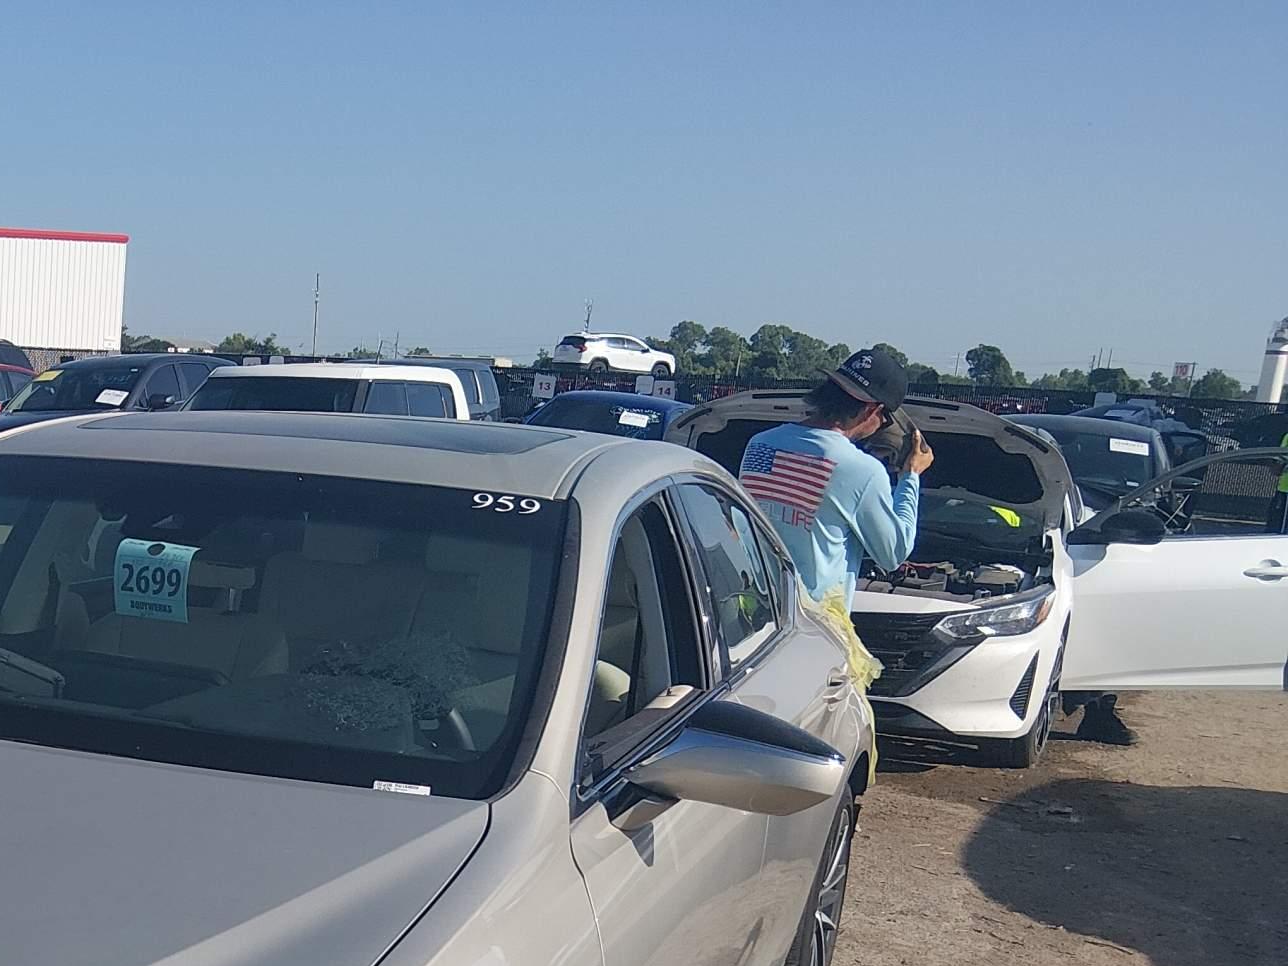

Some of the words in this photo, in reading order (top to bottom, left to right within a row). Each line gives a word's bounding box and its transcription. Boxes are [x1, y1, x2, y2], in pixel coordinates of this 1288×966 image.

[537, 381, 552, 391] 13
[657, 386, 672, 396] 14
[471, 492, 541, 514] 959
[120, 563, 182, 597] 2699
